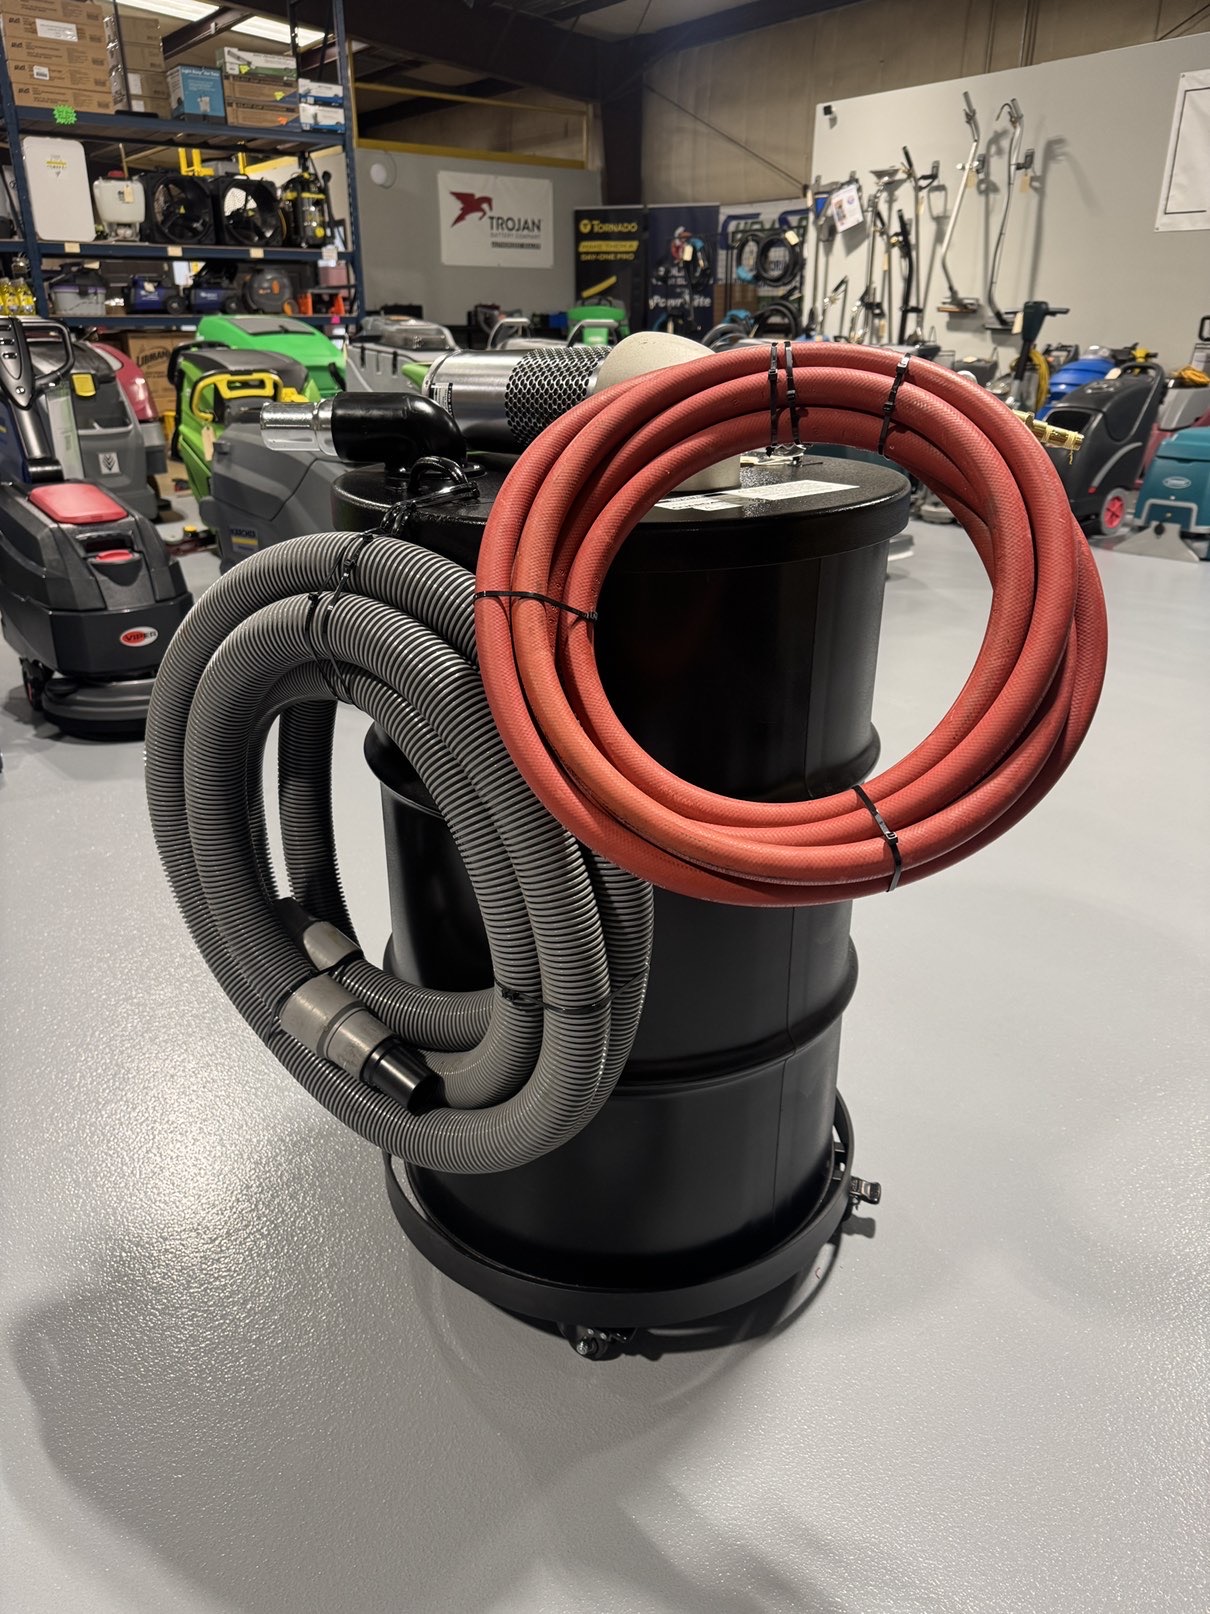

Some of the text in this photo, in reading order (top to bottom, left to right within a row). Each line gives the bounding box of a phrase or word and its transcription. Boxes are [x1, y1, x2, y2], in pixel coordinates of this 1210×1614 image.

[488, 216, 541, 232] TROJAN
[592, 220, 638, 233] TORNADO
[122, 630, 157, 641] VIPER
